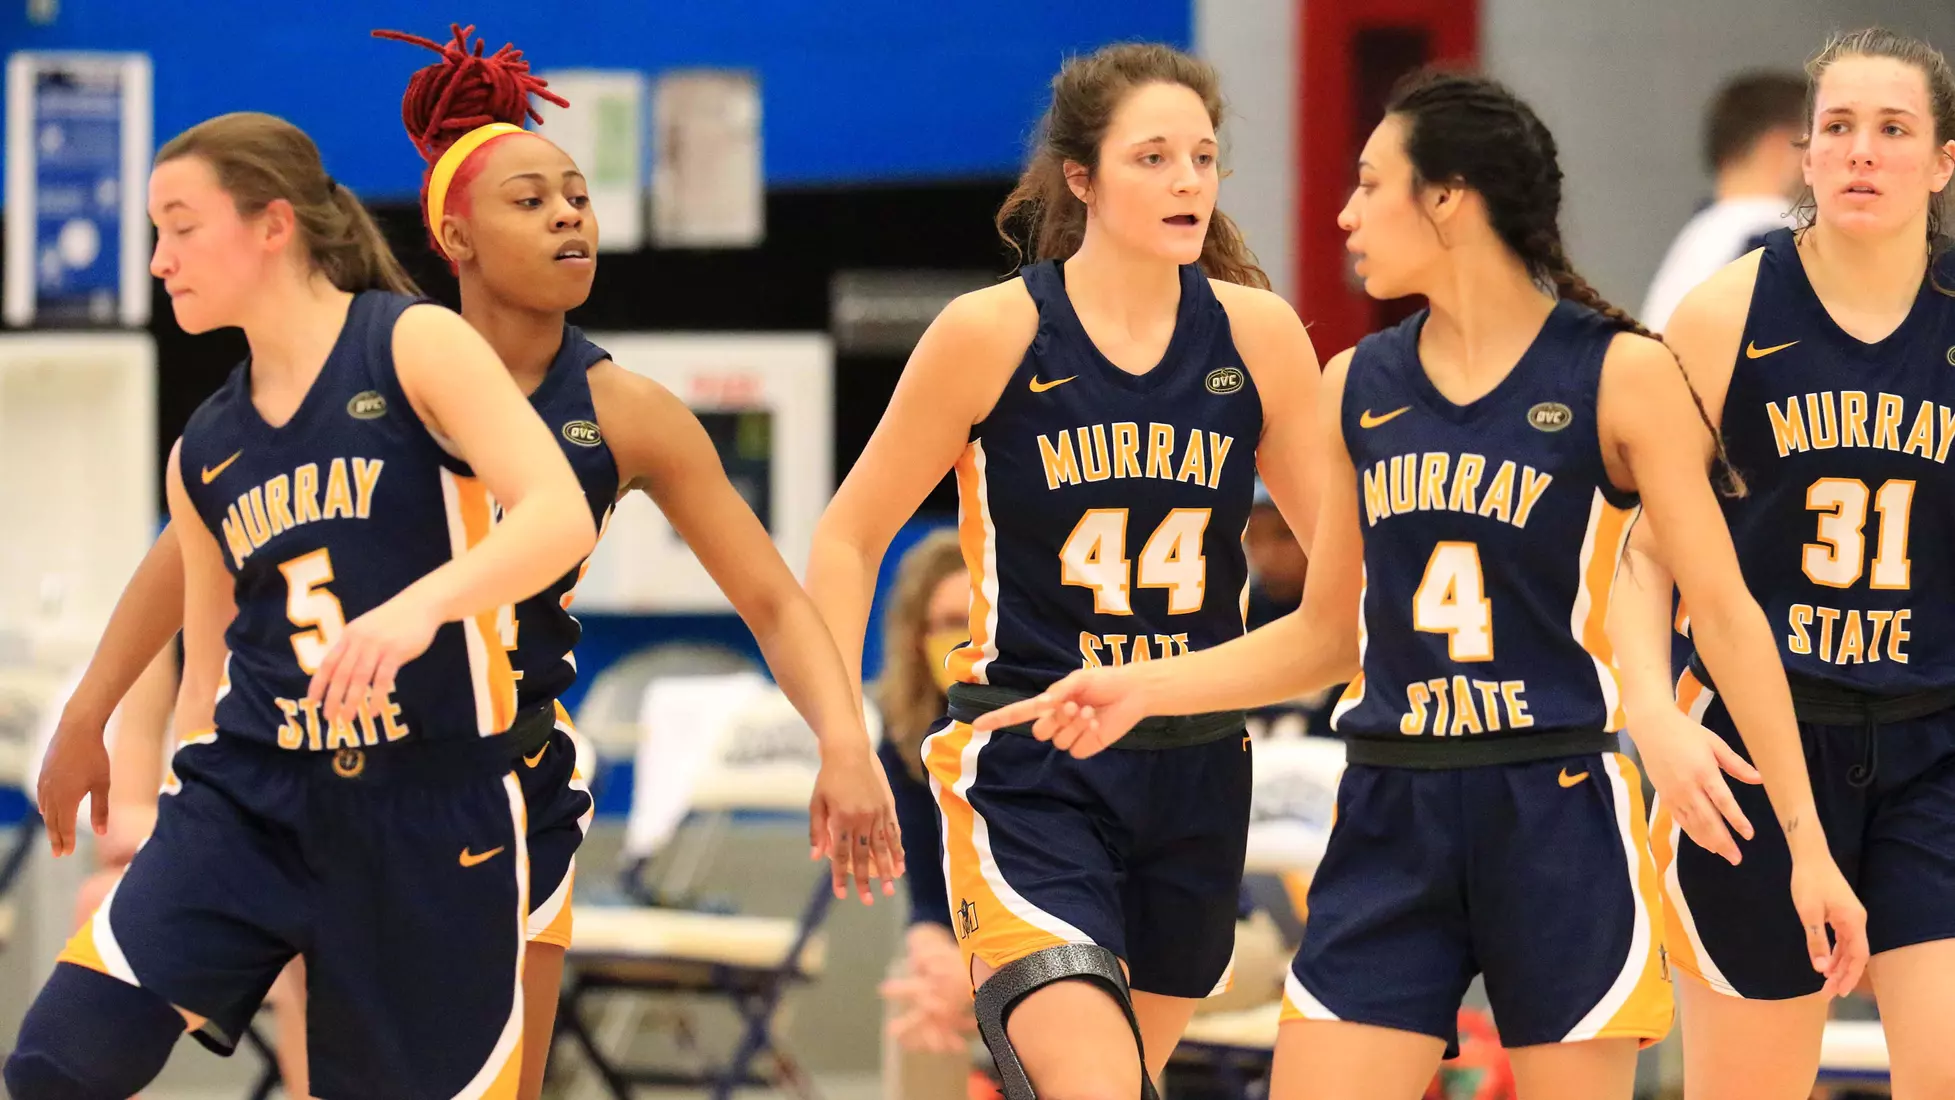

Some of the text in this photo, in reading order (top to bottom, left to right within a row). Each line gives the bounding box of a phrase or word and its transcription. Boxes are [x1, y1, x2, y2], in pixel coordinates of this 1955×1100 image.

[1212, 374, 1237, 388] OVC
[571, 427, 596, 440] OVC
[1036, 421, 1234, 491] MURRAY
[1765, 390, 1955, 464] MURRAY
[221, 456, 385, 570] MURRAY
[1363, 451, 1553, 529] MURRAY
[1058, 507, 1213, 616] 44
[1801, 476, 1917, 590] 31
[277, 546, 349, 676] 5
[1412, 540, 1494, 664] 4
[1788, 603, 1911, 665] STATE
[1400, 675, 1534, 737] STATE
